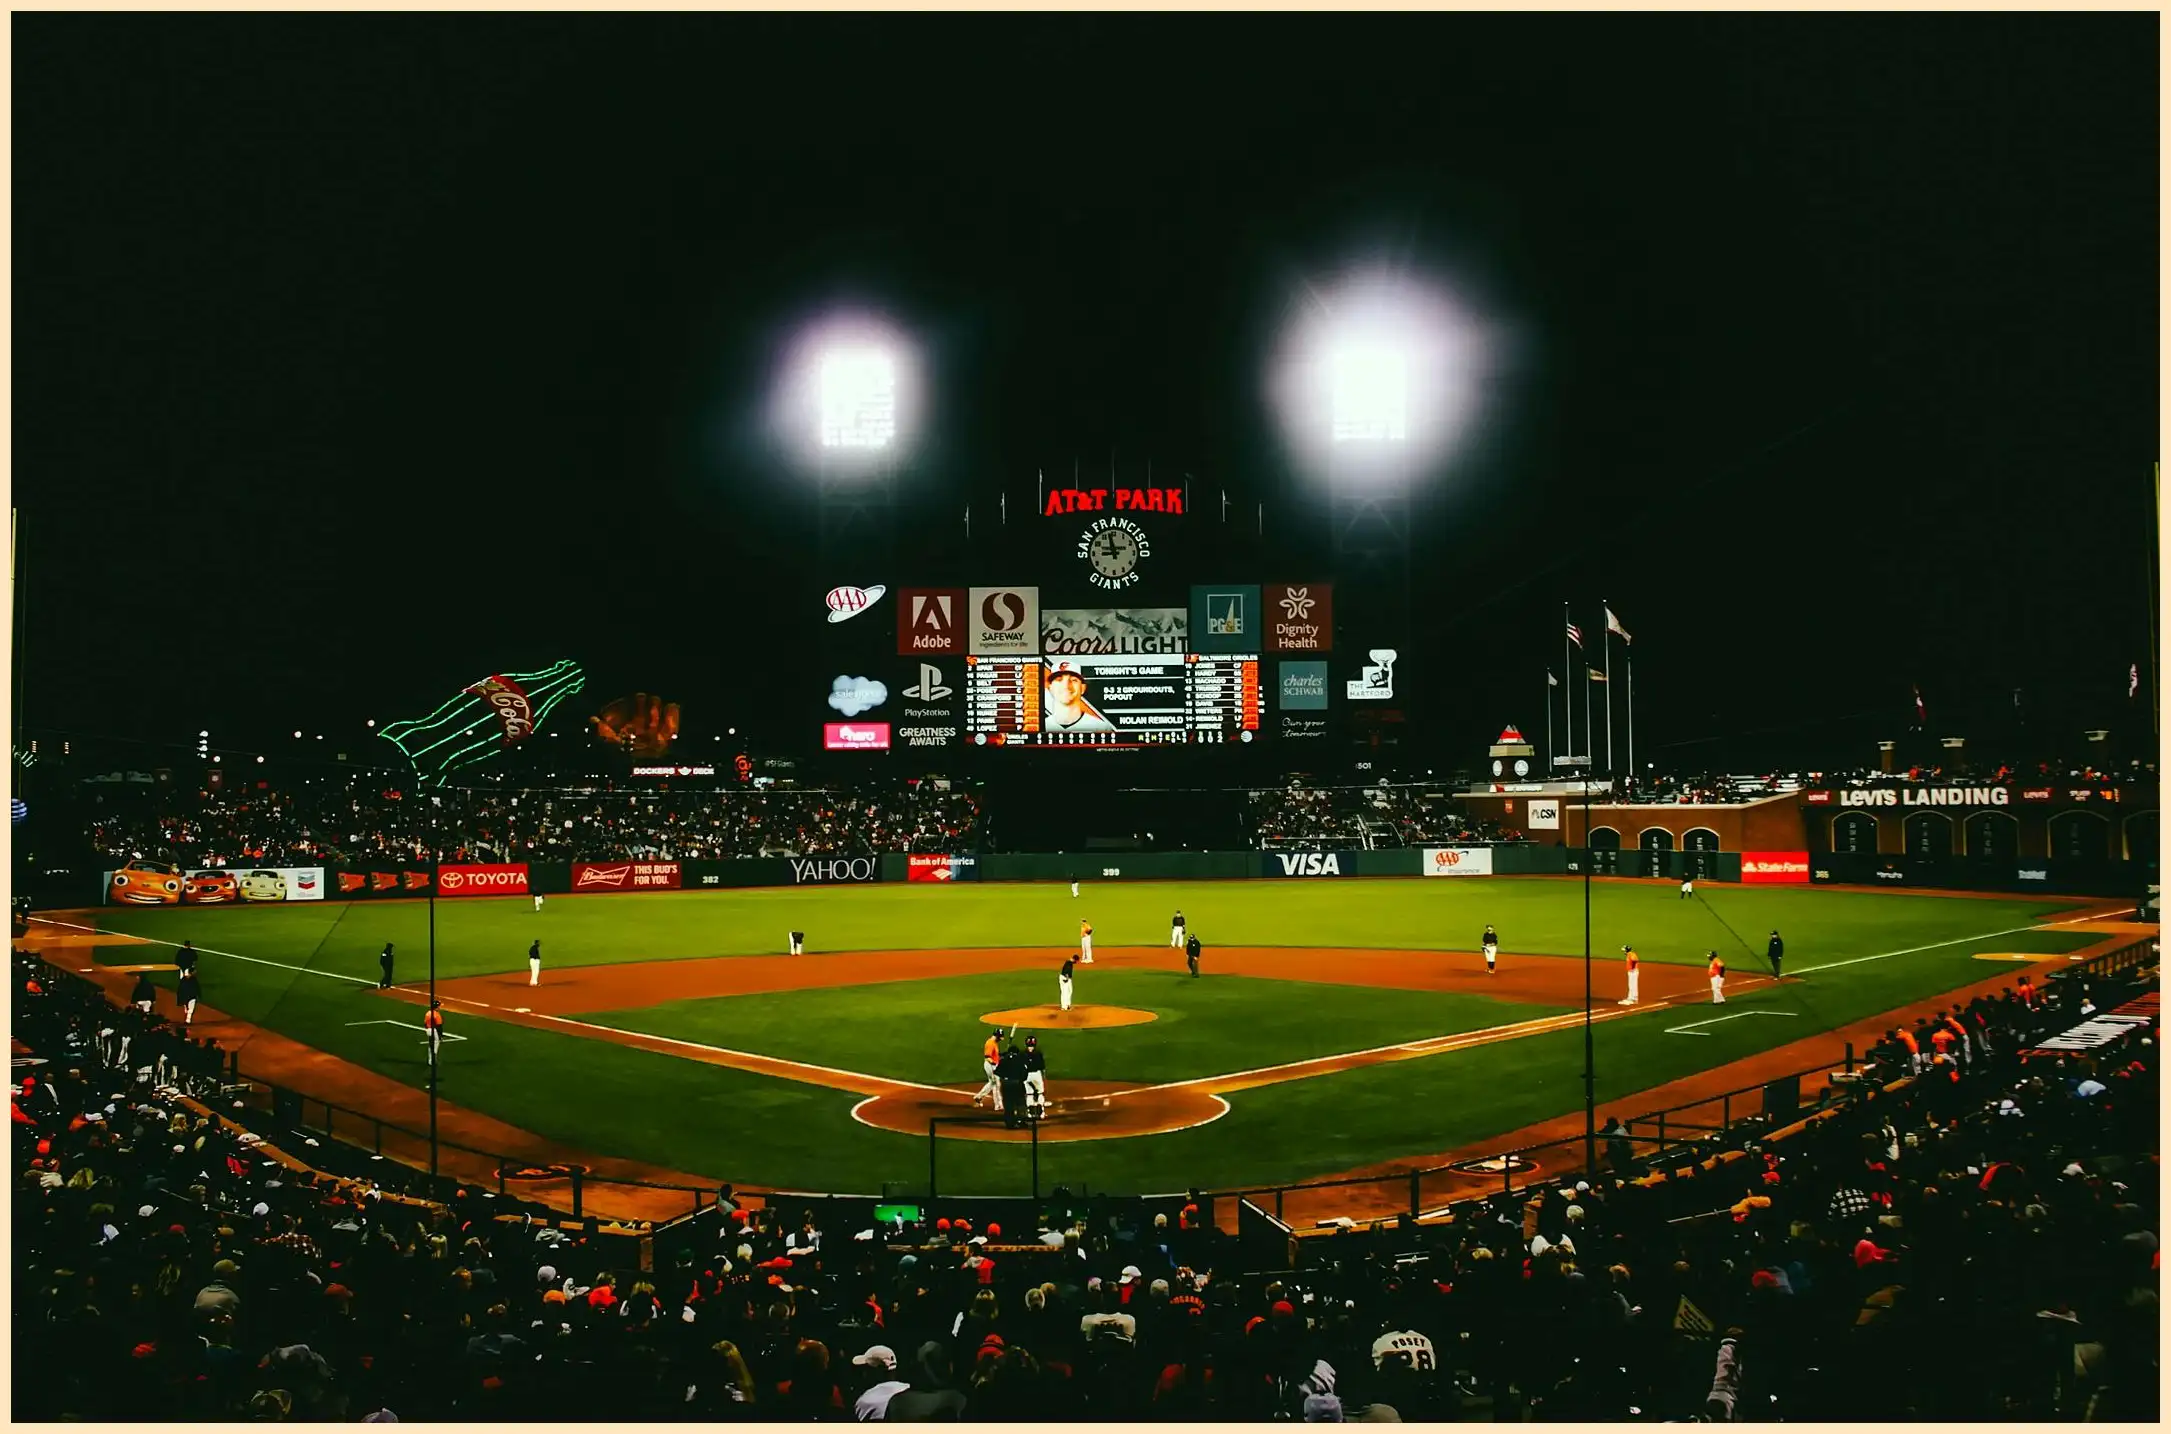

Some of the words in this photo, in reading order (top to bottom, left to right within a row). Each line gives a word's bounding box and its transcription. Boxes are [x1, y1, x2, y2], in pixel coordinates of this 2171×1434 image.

[1045, 489, 1108, 516] AT&T
[1115, 488, 1183, 515] PARK
[1077, 530, 1094, 559] SAN
[1091, 517, 1150, 558] FRANCISCO
[1089, 571, 1139, 590] GIANTS
[829, 588, 867, 611] AAA
[1210, 618, 1243, 633] PG&E
[1276, 623, 1319, 638] Dignity
[913, 635, 951, 648] Adobe
[982, 633, 1024, 641] SAFEWAY
[1044, 628, 1117, 654] Coors
[1121, 636, 1188, 653] LIGHT
[1279, 637, 1318, 648] Health
[1094, 667, 1138, 675] TONIGHT'S
[1139, 667, 1164, 675] GAME
[1283, 674, 1324, 686] charles
[1283, 687, 1324, 696] SCHWAB
[490, 692, 531, 739] Cola
[904, 708, 950, 718] PlayStation
[1148, 716, 1183, 724] REIMOLD
[1282, 717, 1302, 727] Own
[899, 728, 956, 737] GREATNESS
[908, 737, 947, 746] AWAITS
[1903, 787, 2009, 805] LANDING
[1540, 809, 1557, 819] CSN
[910, 857, 931, 866] Bank
[932, 857, 940, 866] of
[941, 857, 975, 866] America
[1276, 853, 1340, 876] VISA
[1436, 852, 1459, 866] AAA
[634, 865, 652, 874] THIS
[654, 865, 678, 873] BUD'S
[790, 857, 876, 883] YAHOO!
[1757, 862, 1784, 872] State
[1784, 862, 1808, 872] Farm
[466, 872, 527, 886] TOYOTA
[634, 876, 650, 885] FOR
[651, 876, 669, 884] YOU.
[1391, 1337, 1426, 1349] POSEY
